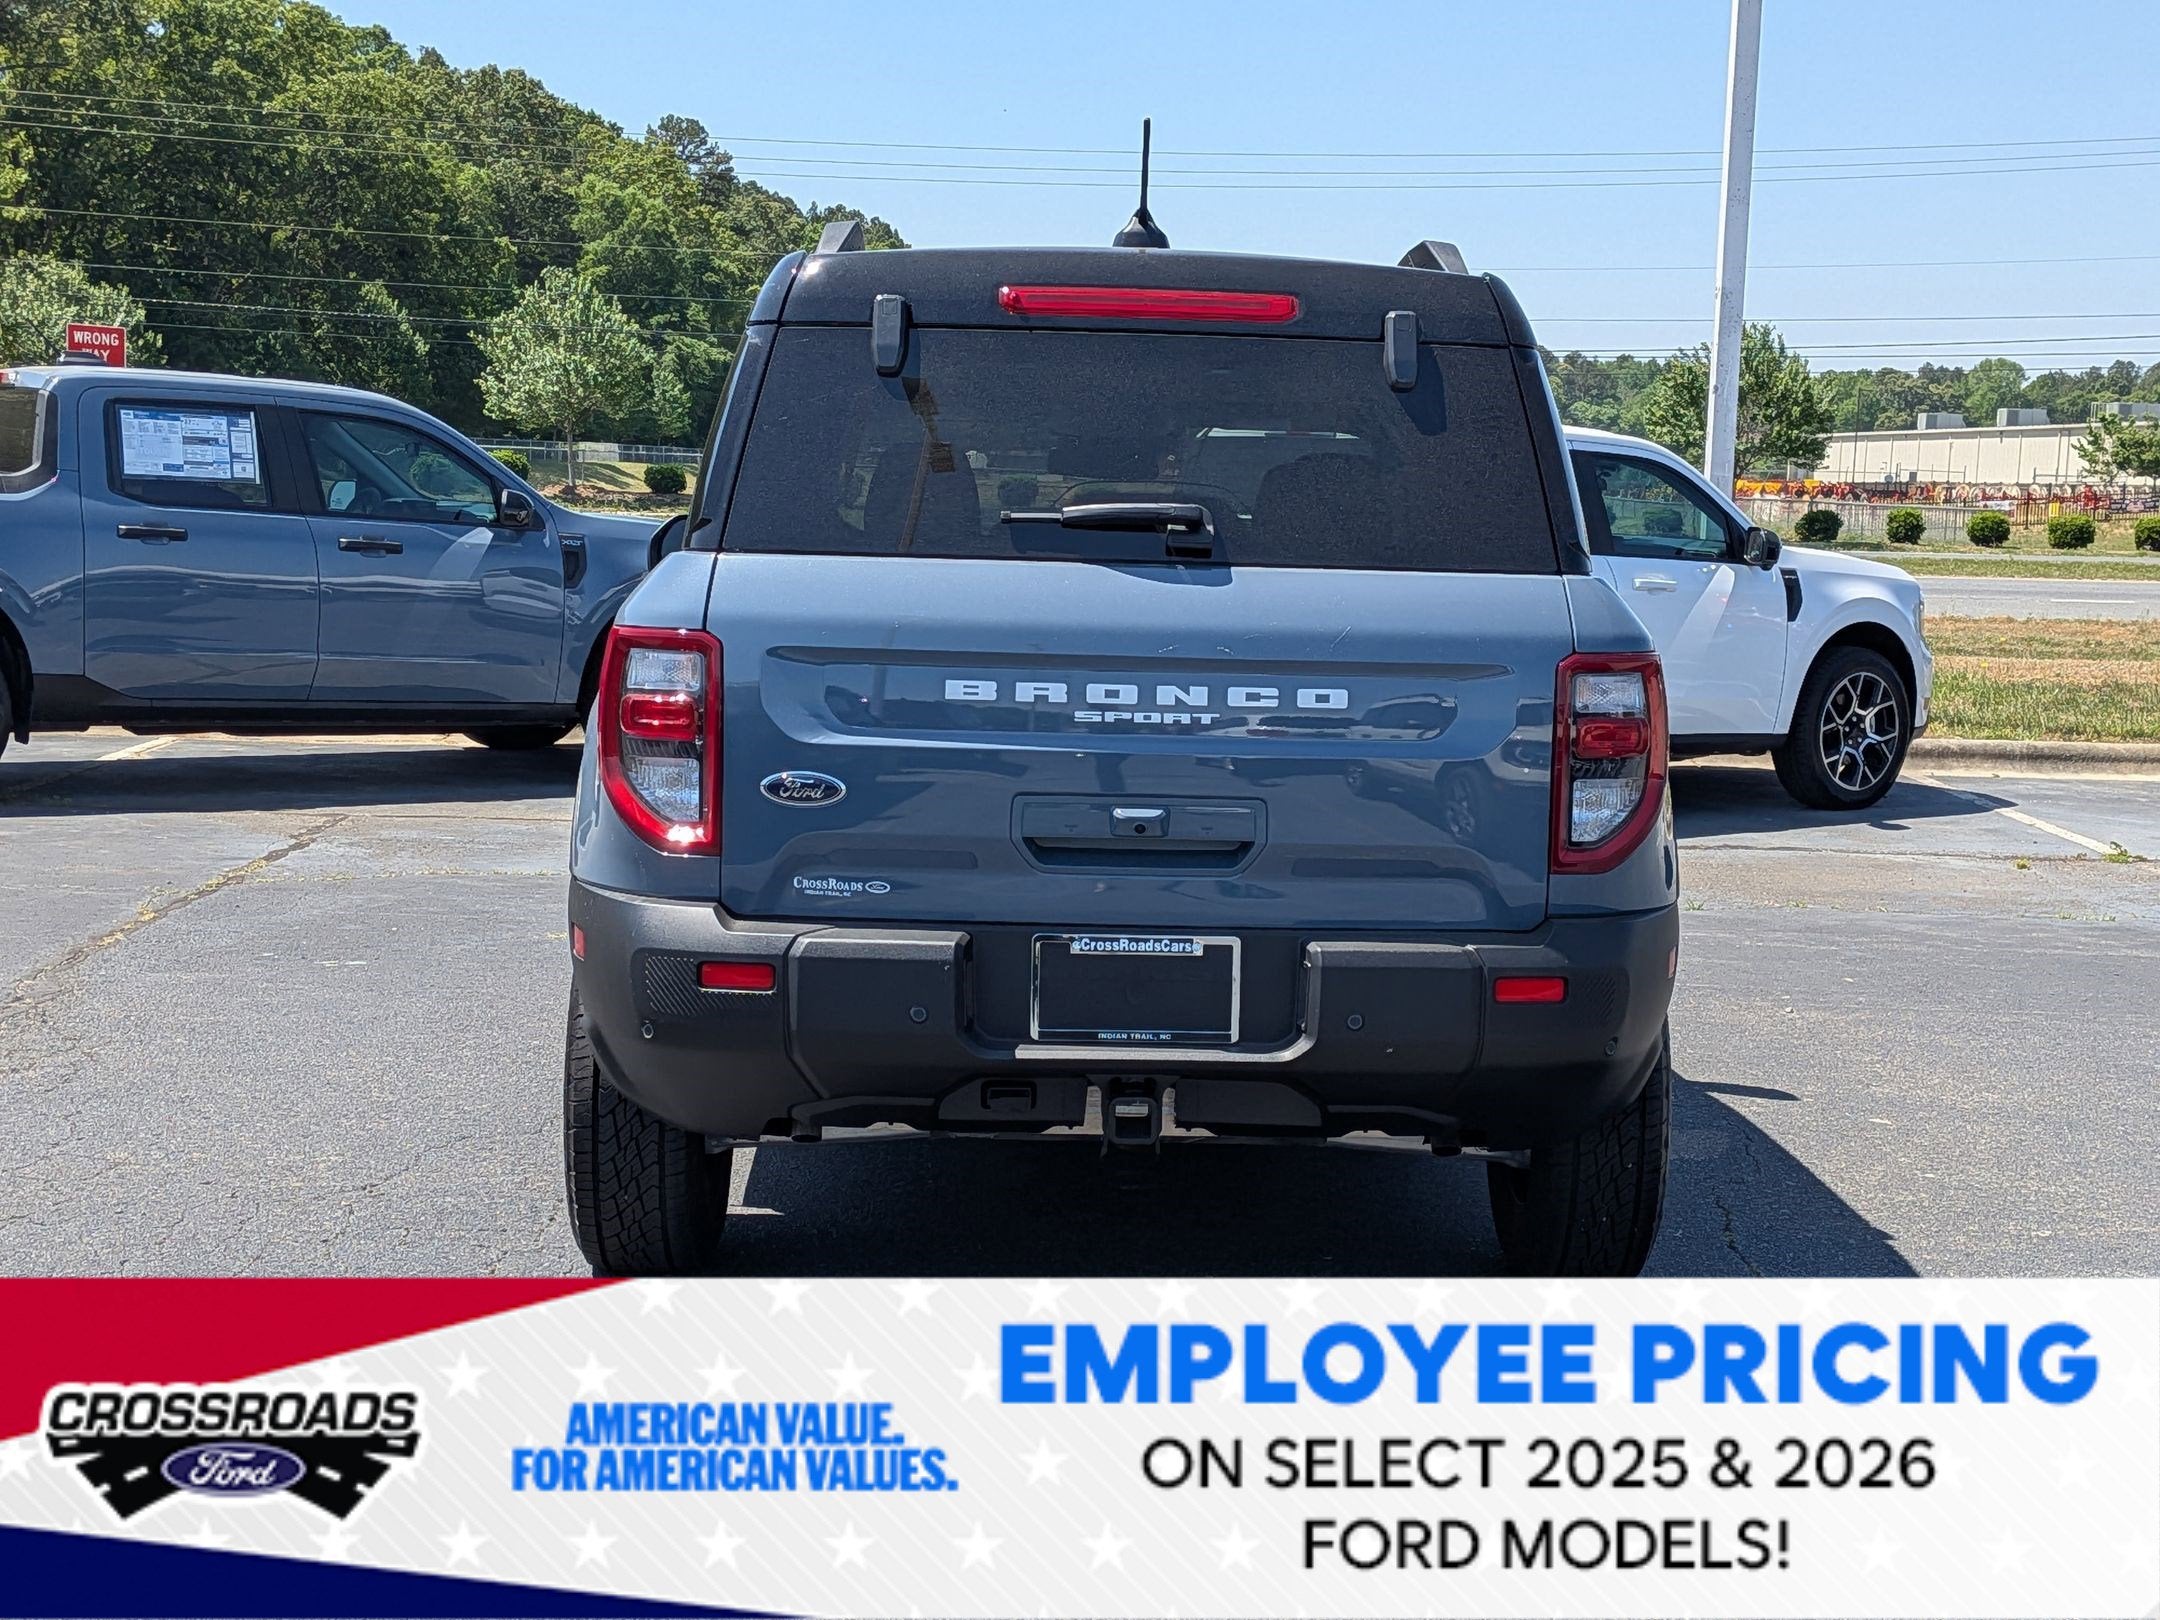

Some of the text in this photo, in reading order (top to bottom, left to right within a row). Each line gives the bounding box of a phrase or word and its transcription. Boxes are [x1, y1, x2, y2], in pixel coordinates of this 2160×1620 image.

[73, 330, 119, 346] WRONG
[82, 348, 110, 362] AY
[944, 679, 1349, 709] BRONCO
[1074, 711, 1220, 725] SPORT
[779, 777, 826, 798] Ford
